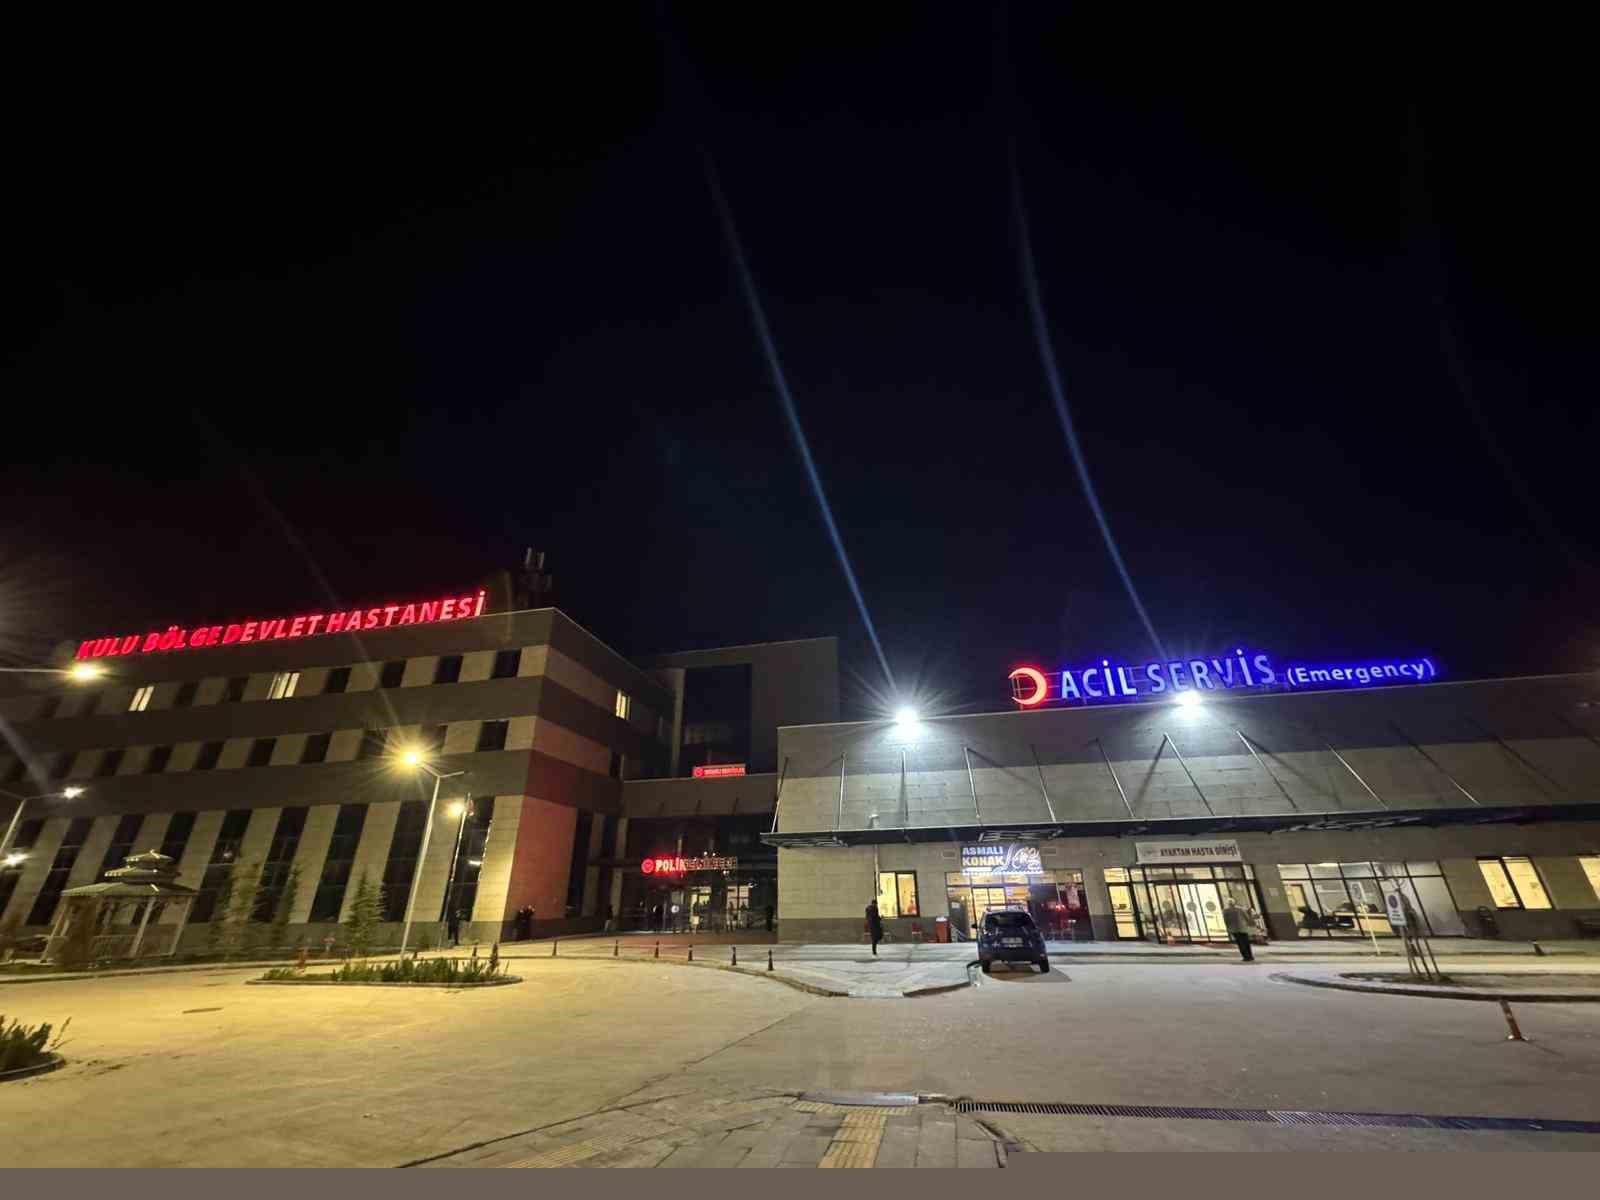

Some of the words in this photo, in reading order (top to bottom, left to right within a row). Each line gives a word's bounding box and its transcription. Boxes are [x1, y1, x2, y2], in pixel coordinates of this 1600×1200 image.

[76, 636, 139, 659] KULU
[142, 626, 222, 652] BÖLGE
[222, 616, 322, 644] DEVLET
[326, 590, 485, 633] HASTANESİ
[1061, 660, 1137, 699] ACİL
[1147, 649, 1276, 693] SERVİS
[1287, 658, 1435, 686] (Emergency)
[962, 846, 1003, 855] ASMALI
[962, 856, 1005, 866] KONAK
